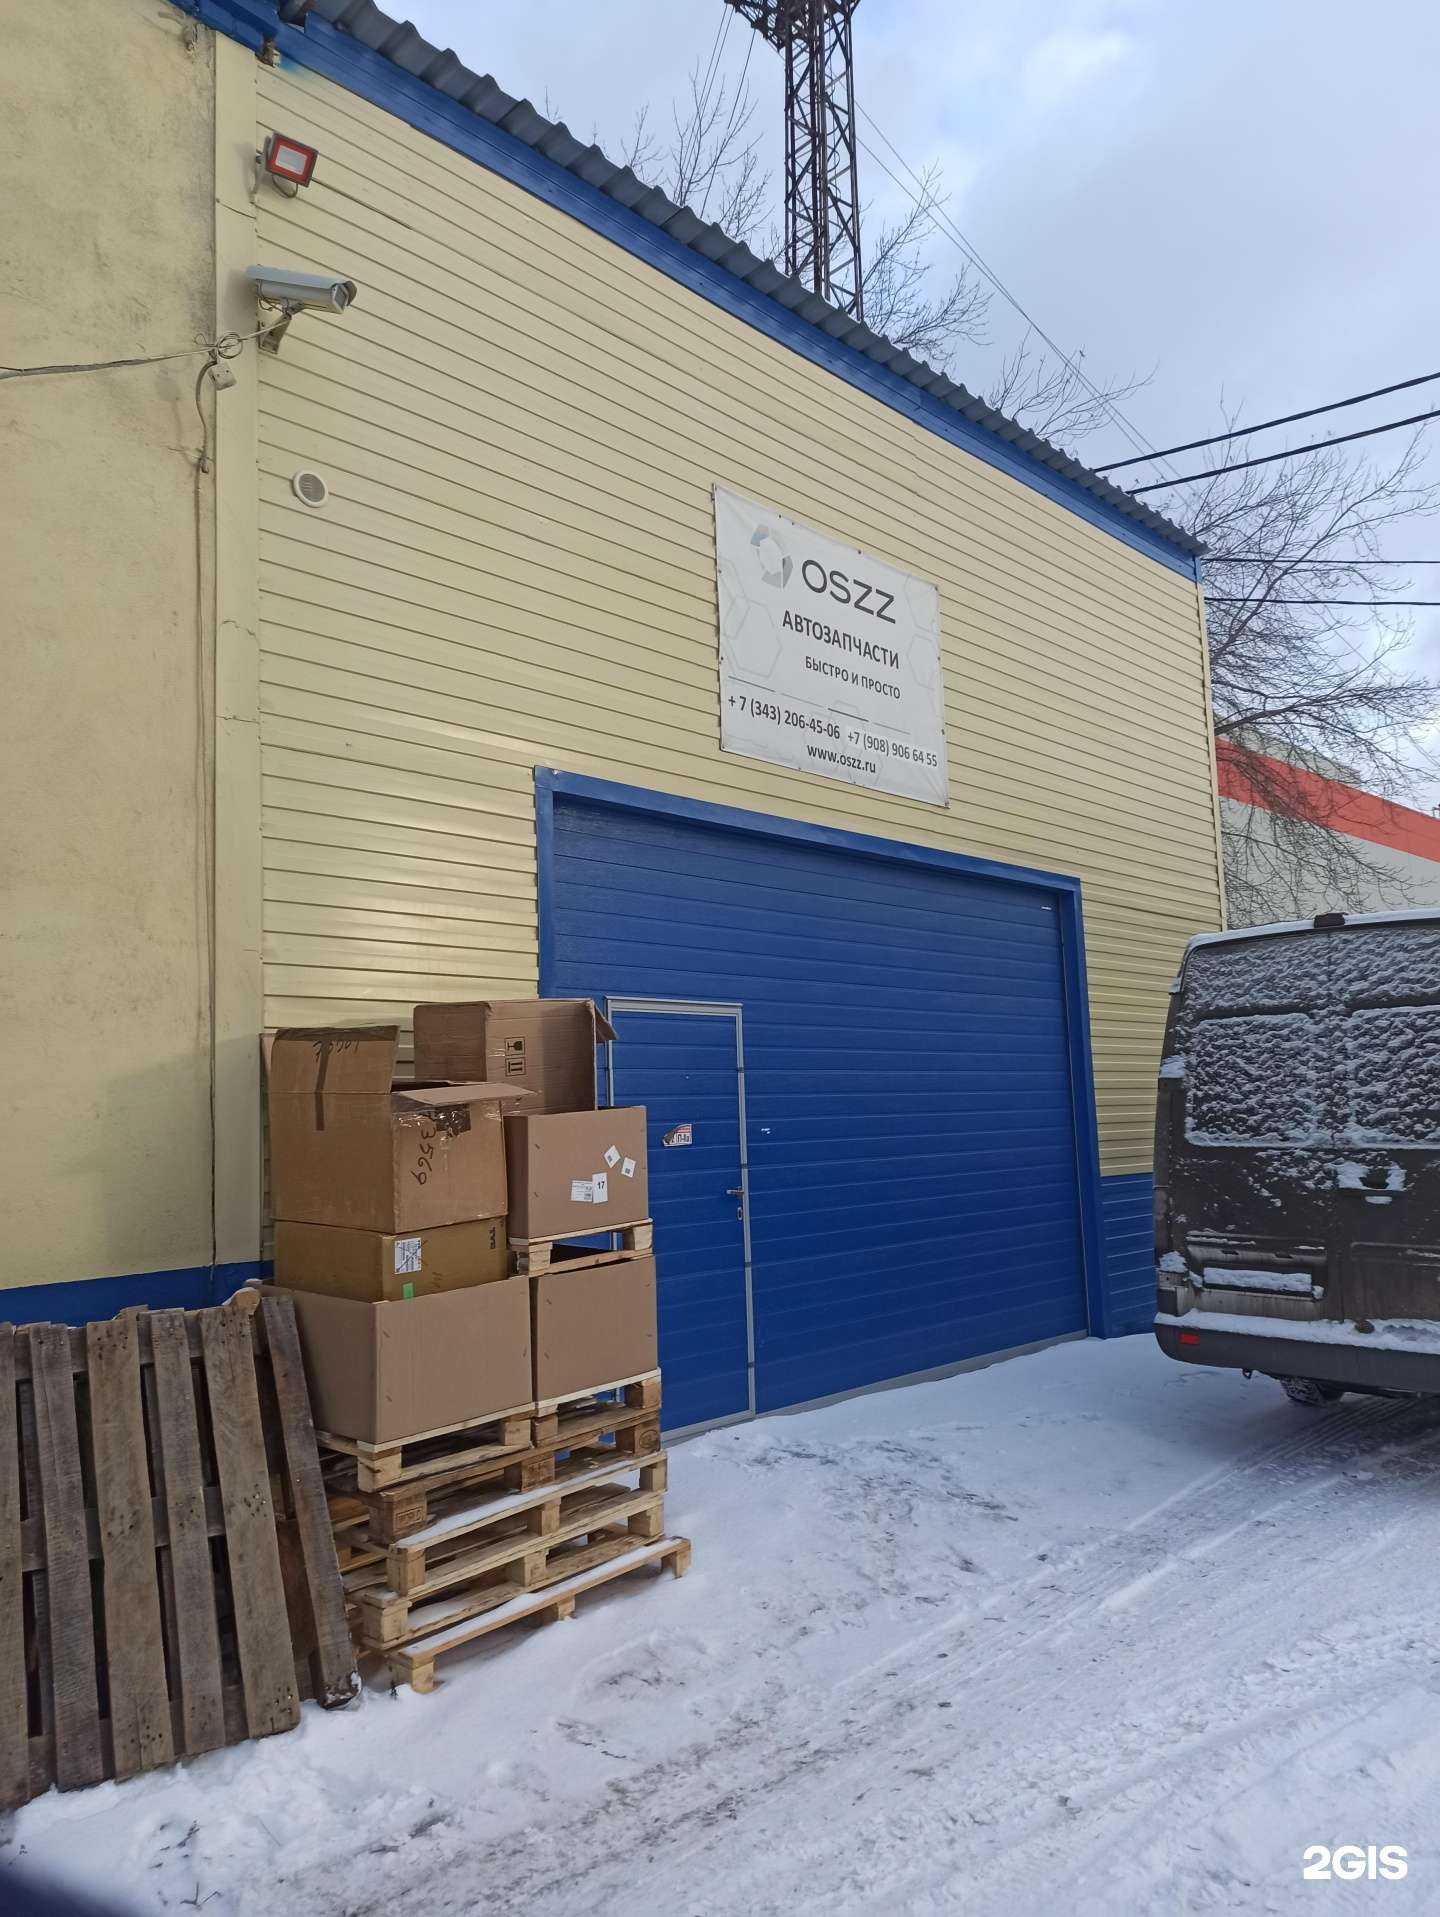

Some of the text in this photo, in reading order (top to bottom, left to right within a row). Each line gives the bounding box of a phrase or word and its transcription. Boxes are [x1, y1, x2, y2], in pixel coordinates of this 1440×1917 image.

[802, 559, 896, 624] OSZZ
[782, 610, 899, 670] АВТОЗАПЧАСТИ
[805, 656, 901, 699] БЫСТРО И ПРОСТО
[750, 698, 781, 725] (343)
[784, 710, 841, 740] 206-45-06
[807, 745, 876, 774] www.oszz.ru
[847, 731, 938, 768] +7 (908) 906 64 55
[597, 1181, 605, 1190] 17
